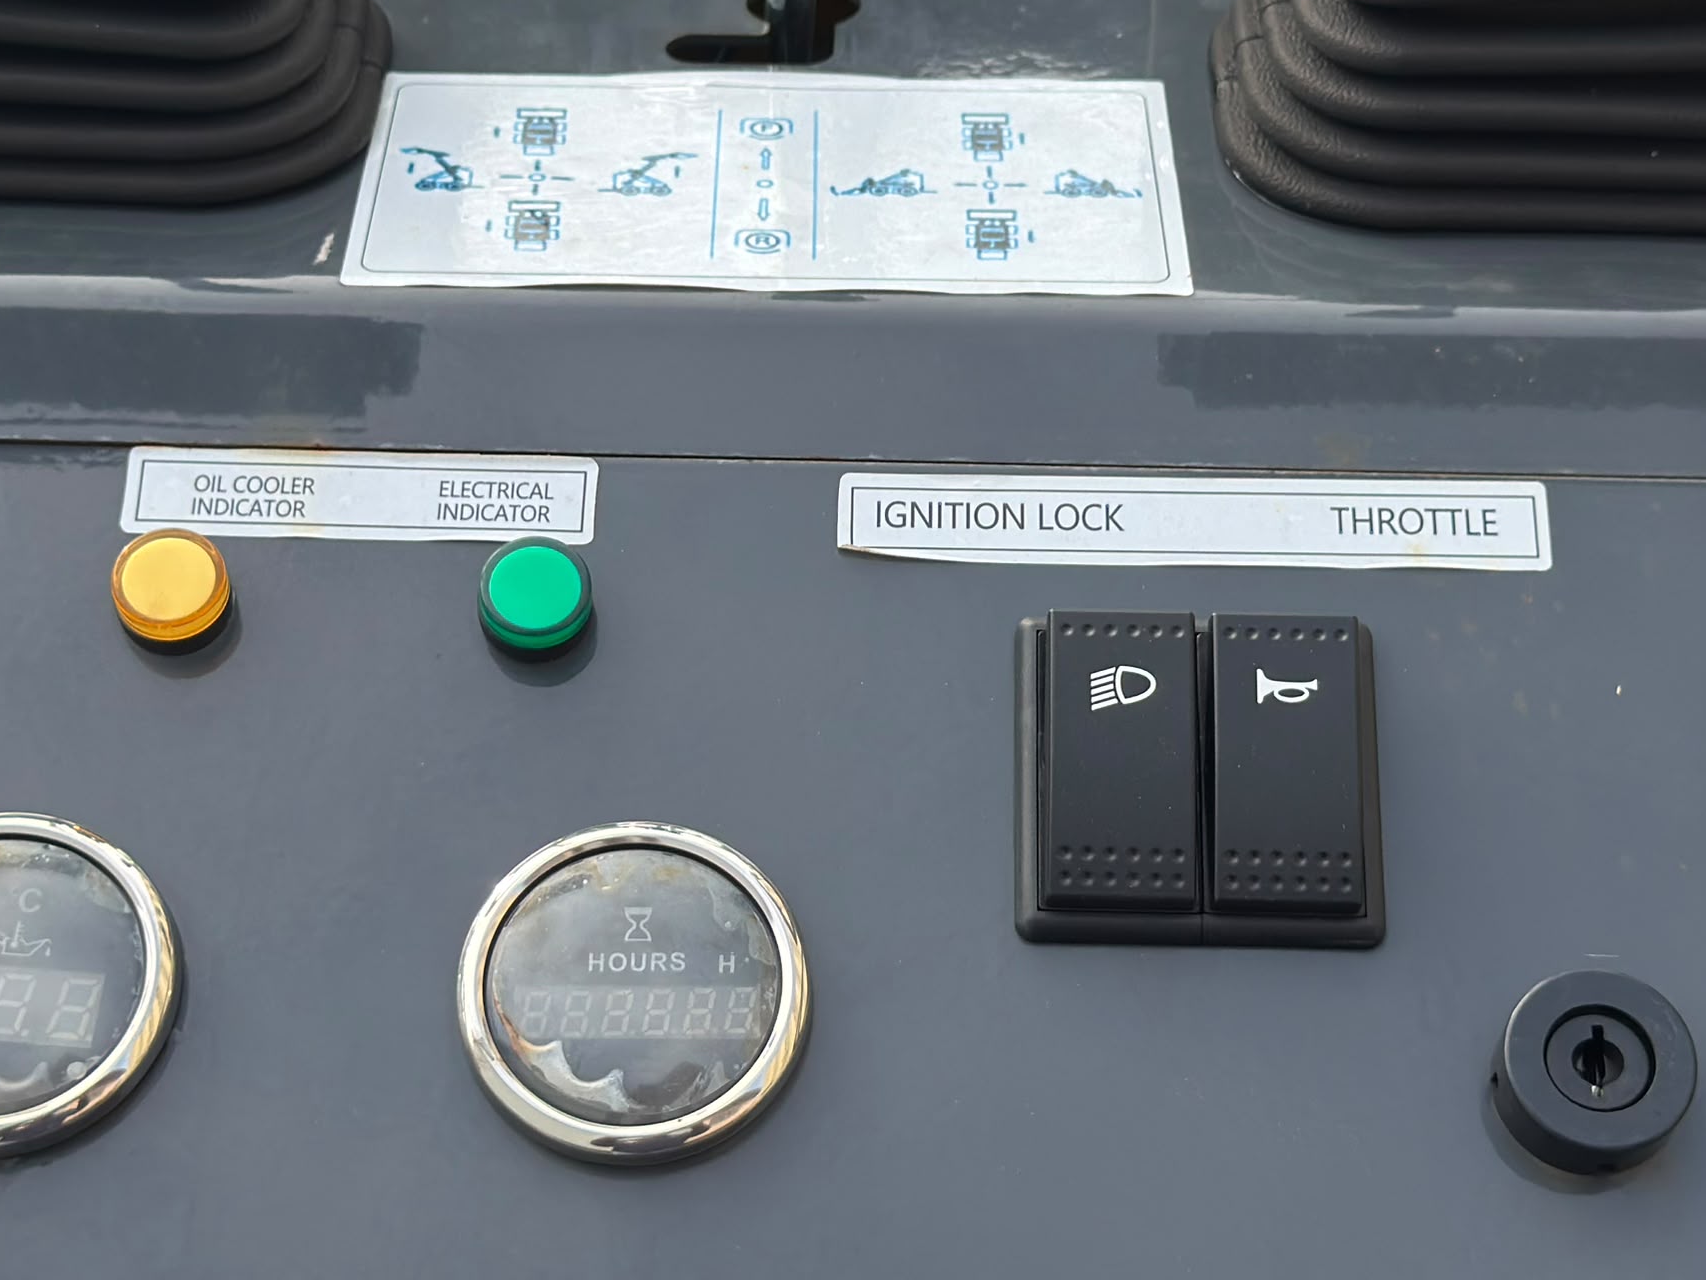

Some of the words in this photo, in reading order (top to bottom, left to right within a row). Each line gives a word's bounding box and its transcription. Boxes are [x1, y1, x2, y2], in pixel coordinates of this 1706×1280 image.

[193, 474, 227, 495] OIL
[232, 475, 315, 496] COOLER
[439, 480, 554, 500] ELECTRICAL
[191, 498, 306, 519] INDICATOR
[436, 502, 550, 523] INDICATOR
[876, 500, 1025, 530] IGNITION
[1038, 501, 1125, 532] LOCK
[1329, 506, 1499, 537] THROTTLE
[588, 951, 686, 972] HOURS
[718, 954, 735, 973] H
